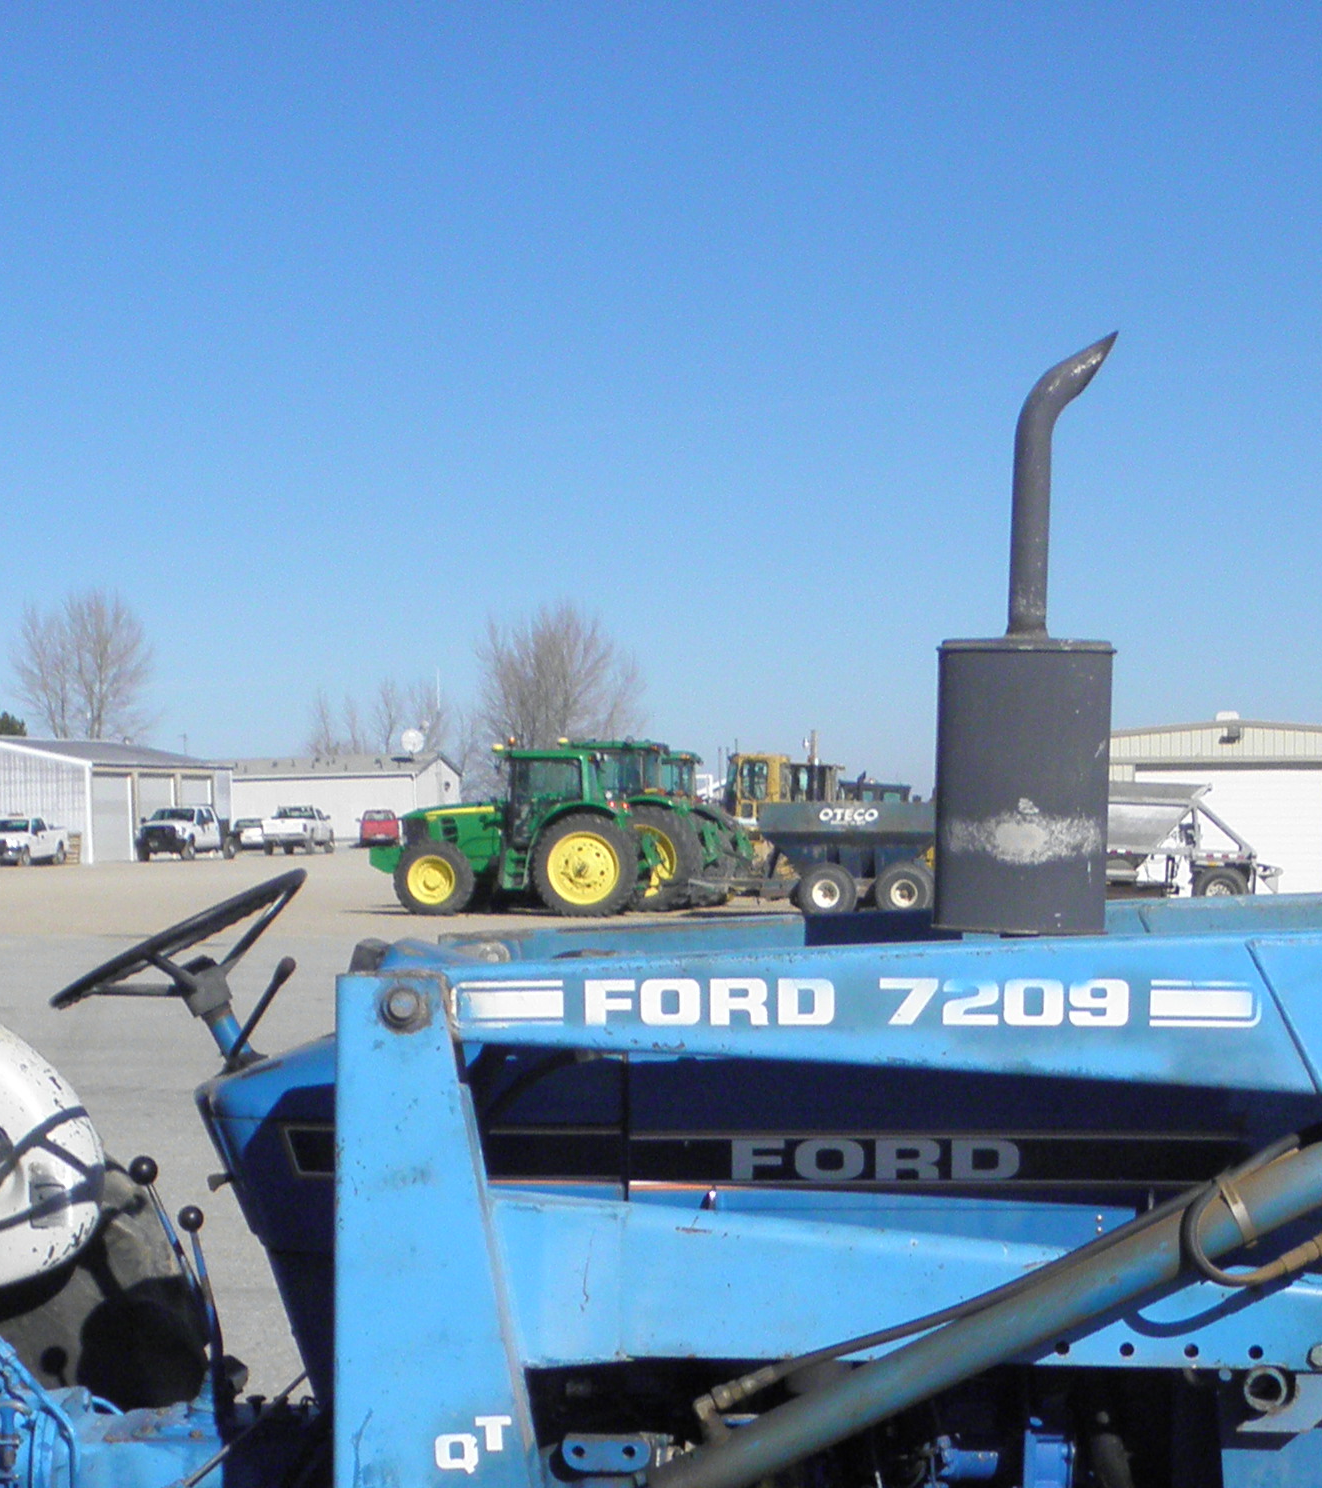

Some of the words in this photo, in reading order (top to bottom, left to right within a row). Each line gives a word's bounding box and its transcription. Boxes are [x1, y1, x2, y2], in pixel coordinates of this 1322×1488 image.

[818, 807, 879, 822] OTECO
[584, 978, 836, 1027] FORD
[878, 977, 1130, 1027] 7209
[730, 1137, 1020, 1181] FORD
[434, 1414, 512, 1475] QT
